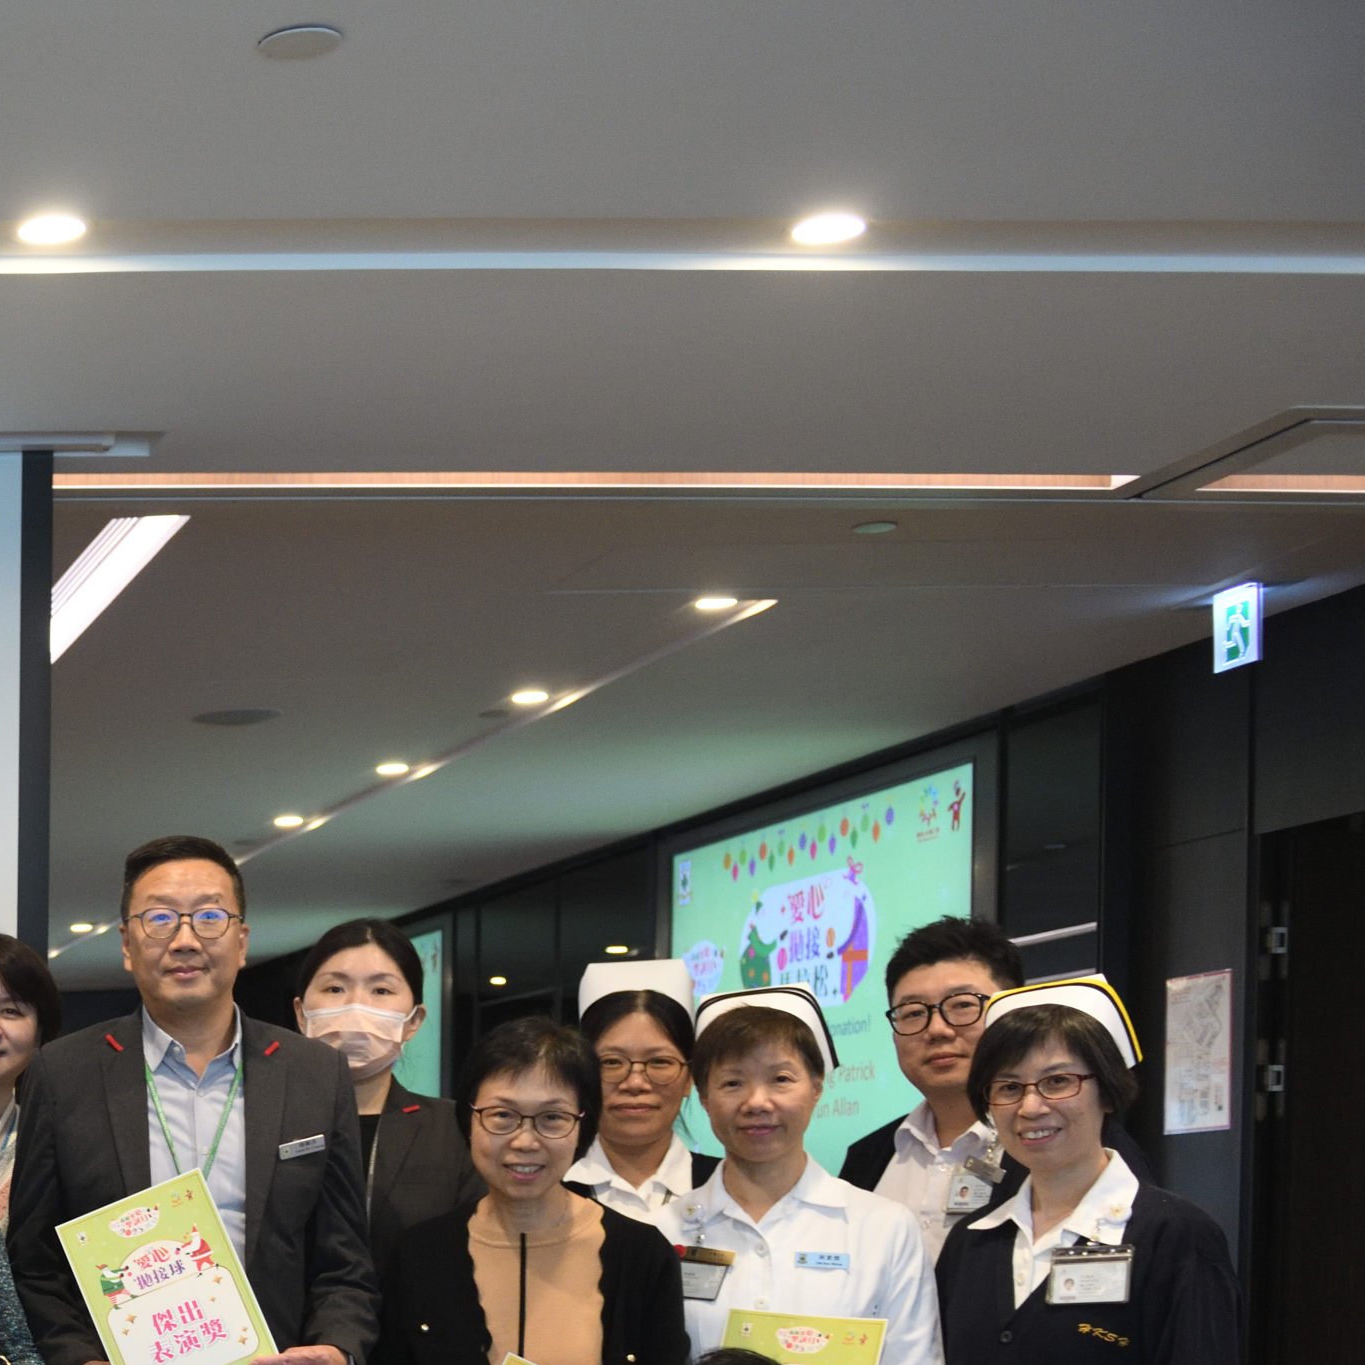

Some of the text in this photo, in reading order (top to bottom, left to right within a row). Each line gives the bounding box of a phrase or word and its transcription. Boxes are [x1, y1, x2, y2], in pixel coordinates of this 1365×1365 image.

[133, 1247, 170, 1270] 愛心
[136, 1260, 186, 1290] 拋接球
[152, 1300, 204, 1335] 傑出
[152, 1319, 228, 1364] 表演獎
